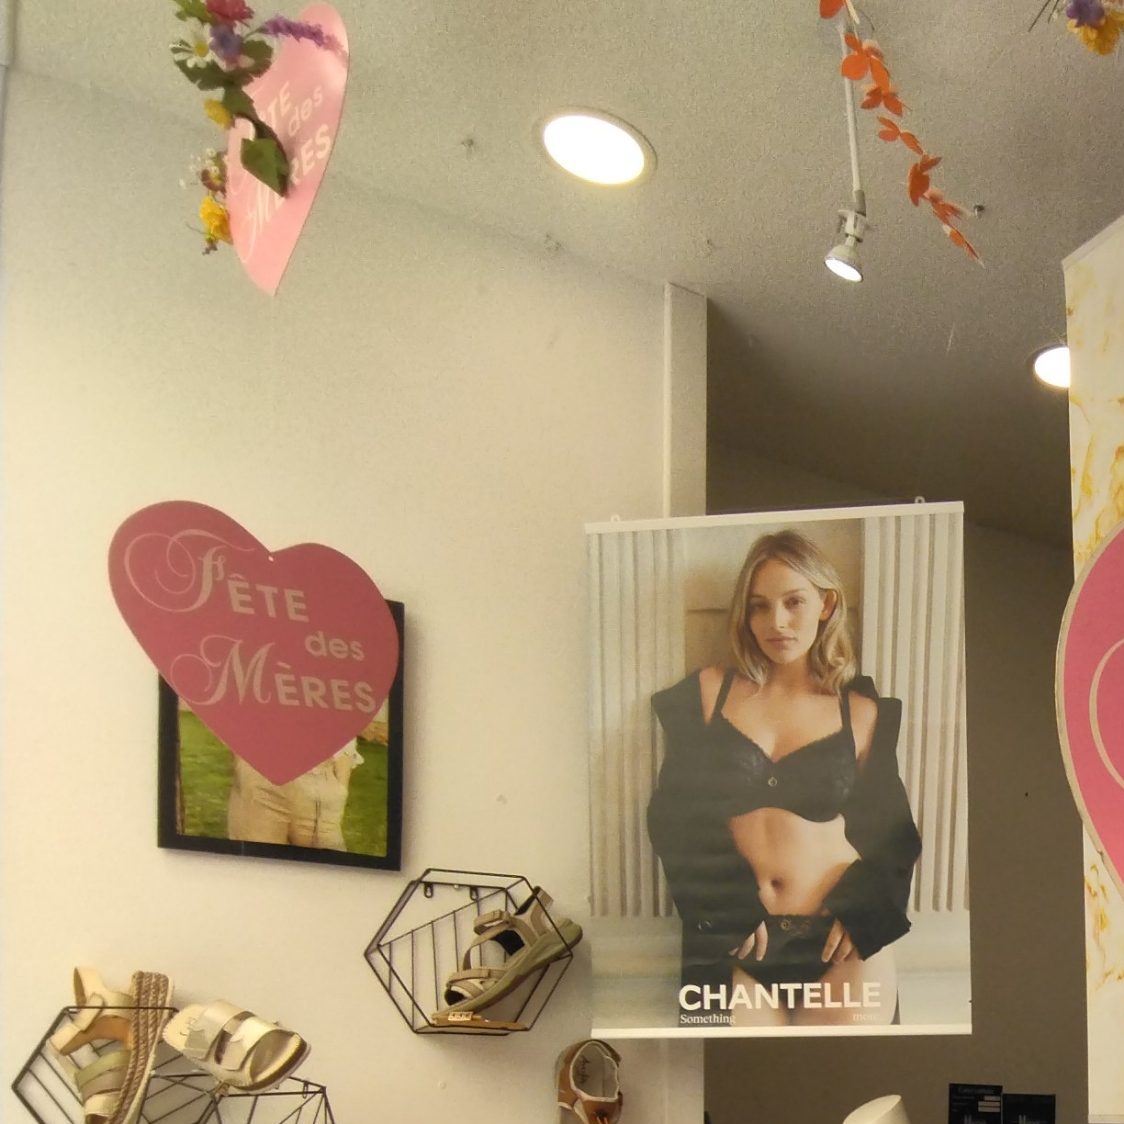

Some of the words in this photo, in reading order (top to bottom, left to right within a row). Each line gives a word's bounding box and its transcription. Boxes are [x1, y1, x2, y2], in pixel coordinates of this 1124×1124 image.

[124, 529, 309, 622] FÊTE
[304, 631, 366, 662] des
[170, 634, 377, 713] MÈRES
[678, 981, 882, 1011] CHANTELLE
[680, 1012, 737, 1025] Something
